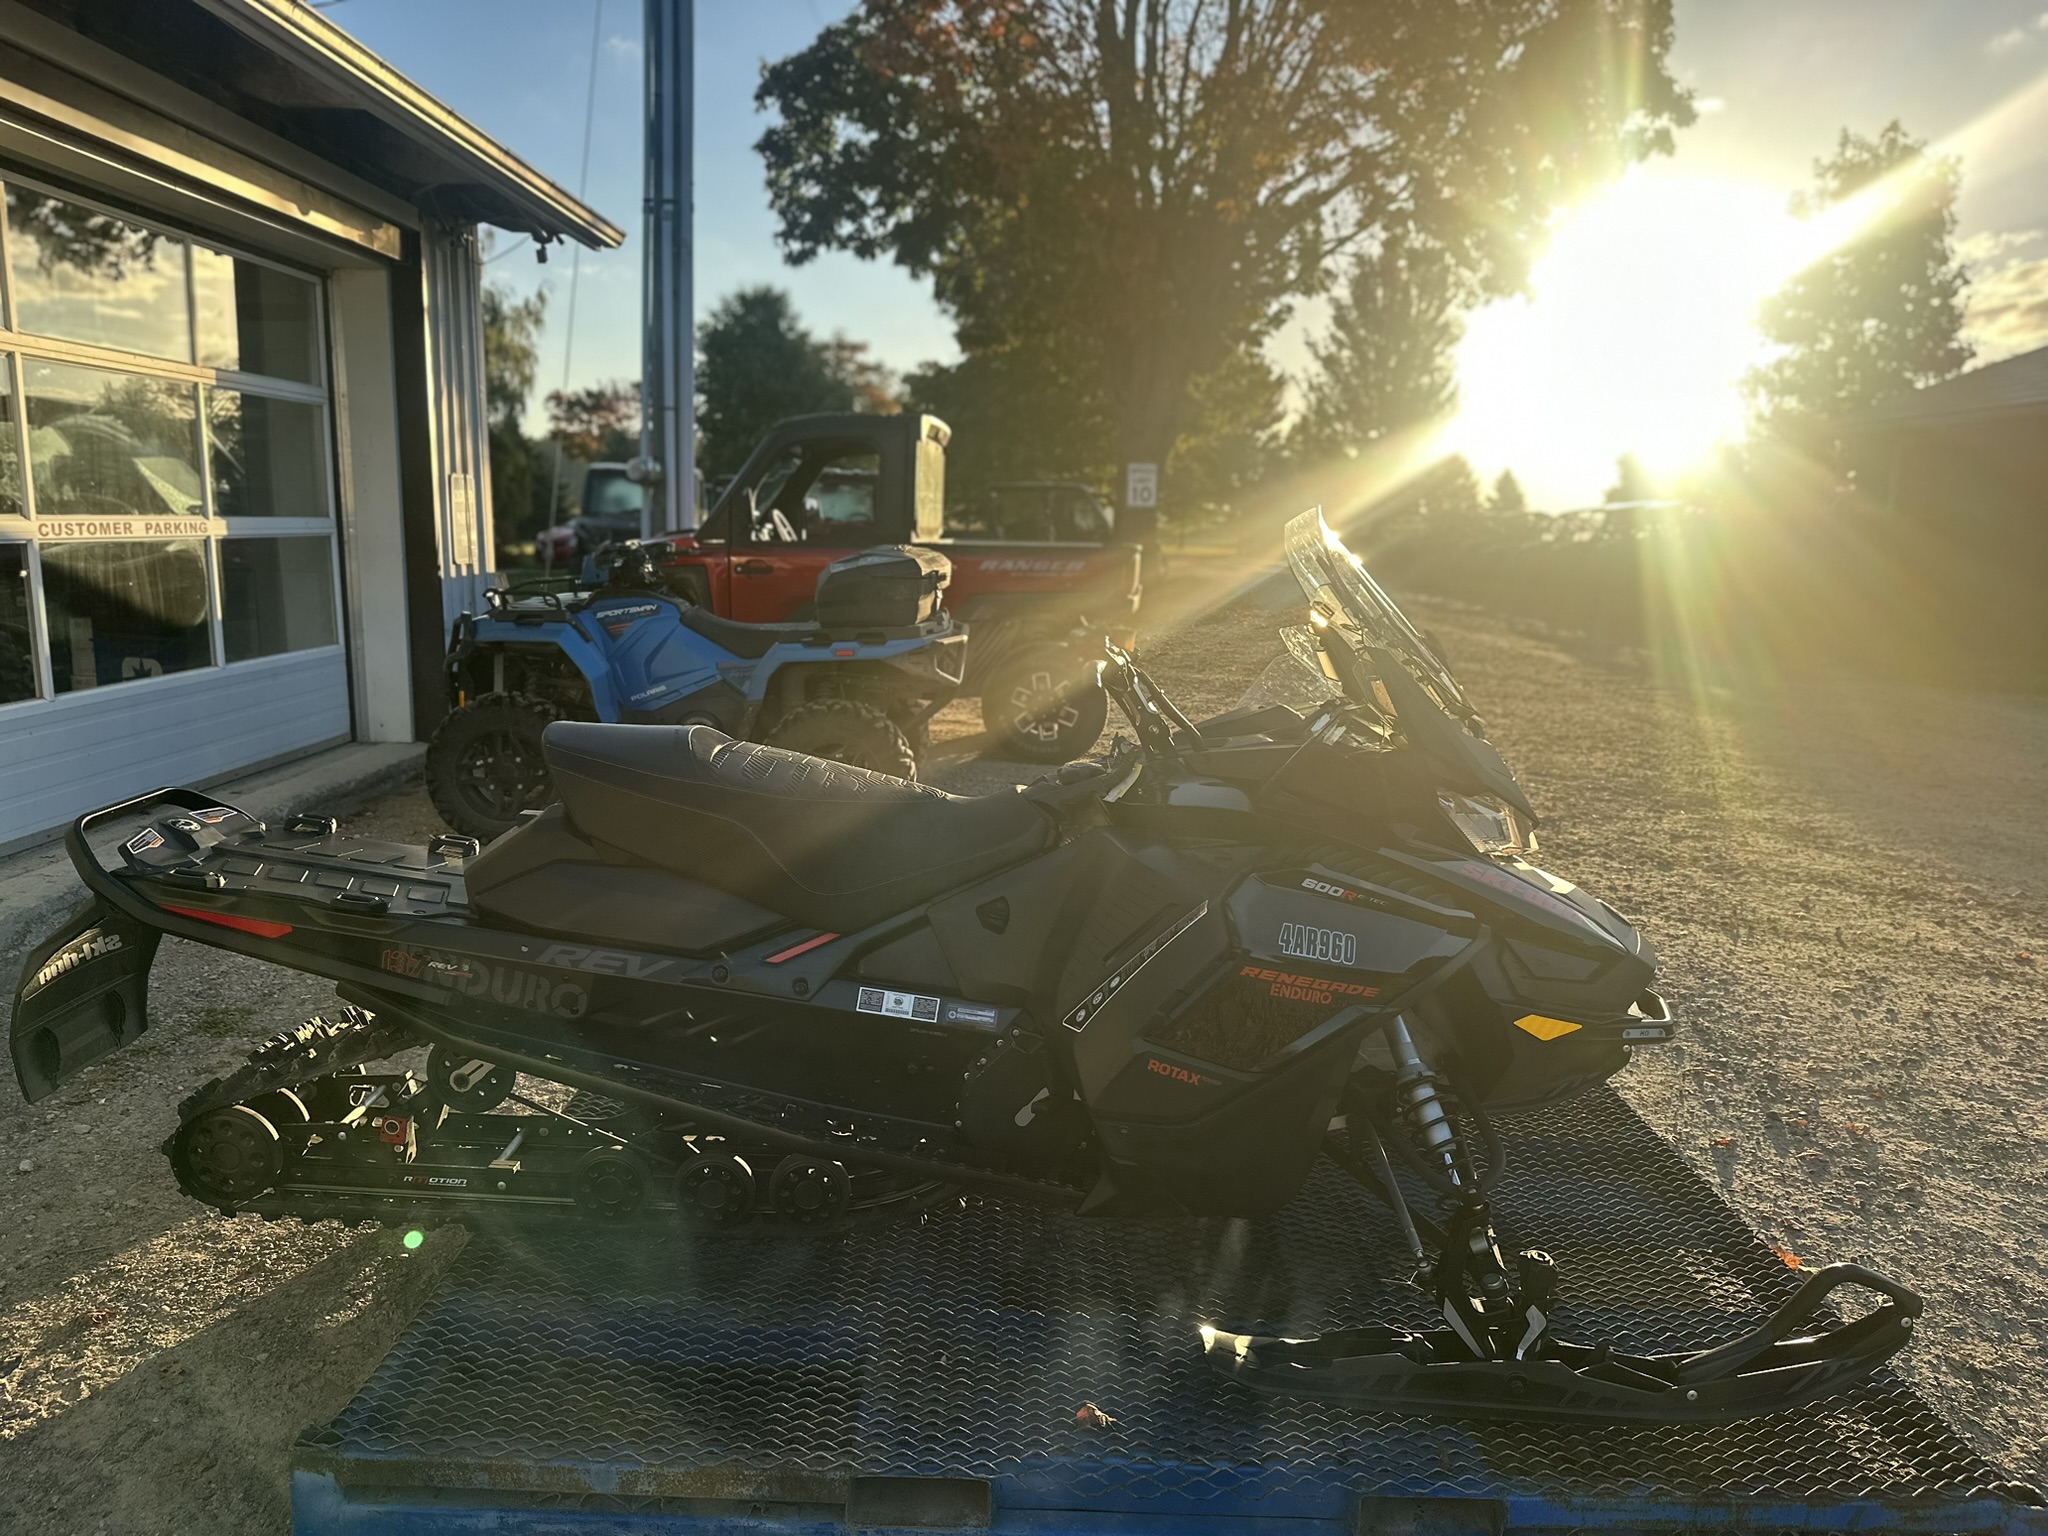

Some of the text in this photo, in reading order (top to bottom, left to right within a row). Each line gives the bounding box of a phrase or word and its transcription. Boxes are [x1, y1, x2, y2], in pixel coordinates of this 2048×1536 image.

[1132, 486, 1152, 503] 10
[38, 521, 208, 537] CUSTOMER PARKING
[595, 604, 658, 619] SPORTSMAN
[630, 685, 667, 701] POLARIS
[1278, 922, 1357, 965] 4AR960
[535, 944, 677, 978] REV
[1239, 966, 1381, 998] RENEGADE
[1269, 983, 1333, 1004] ENDURO
[1146, 1058, 1201, 1086] ROTAX
